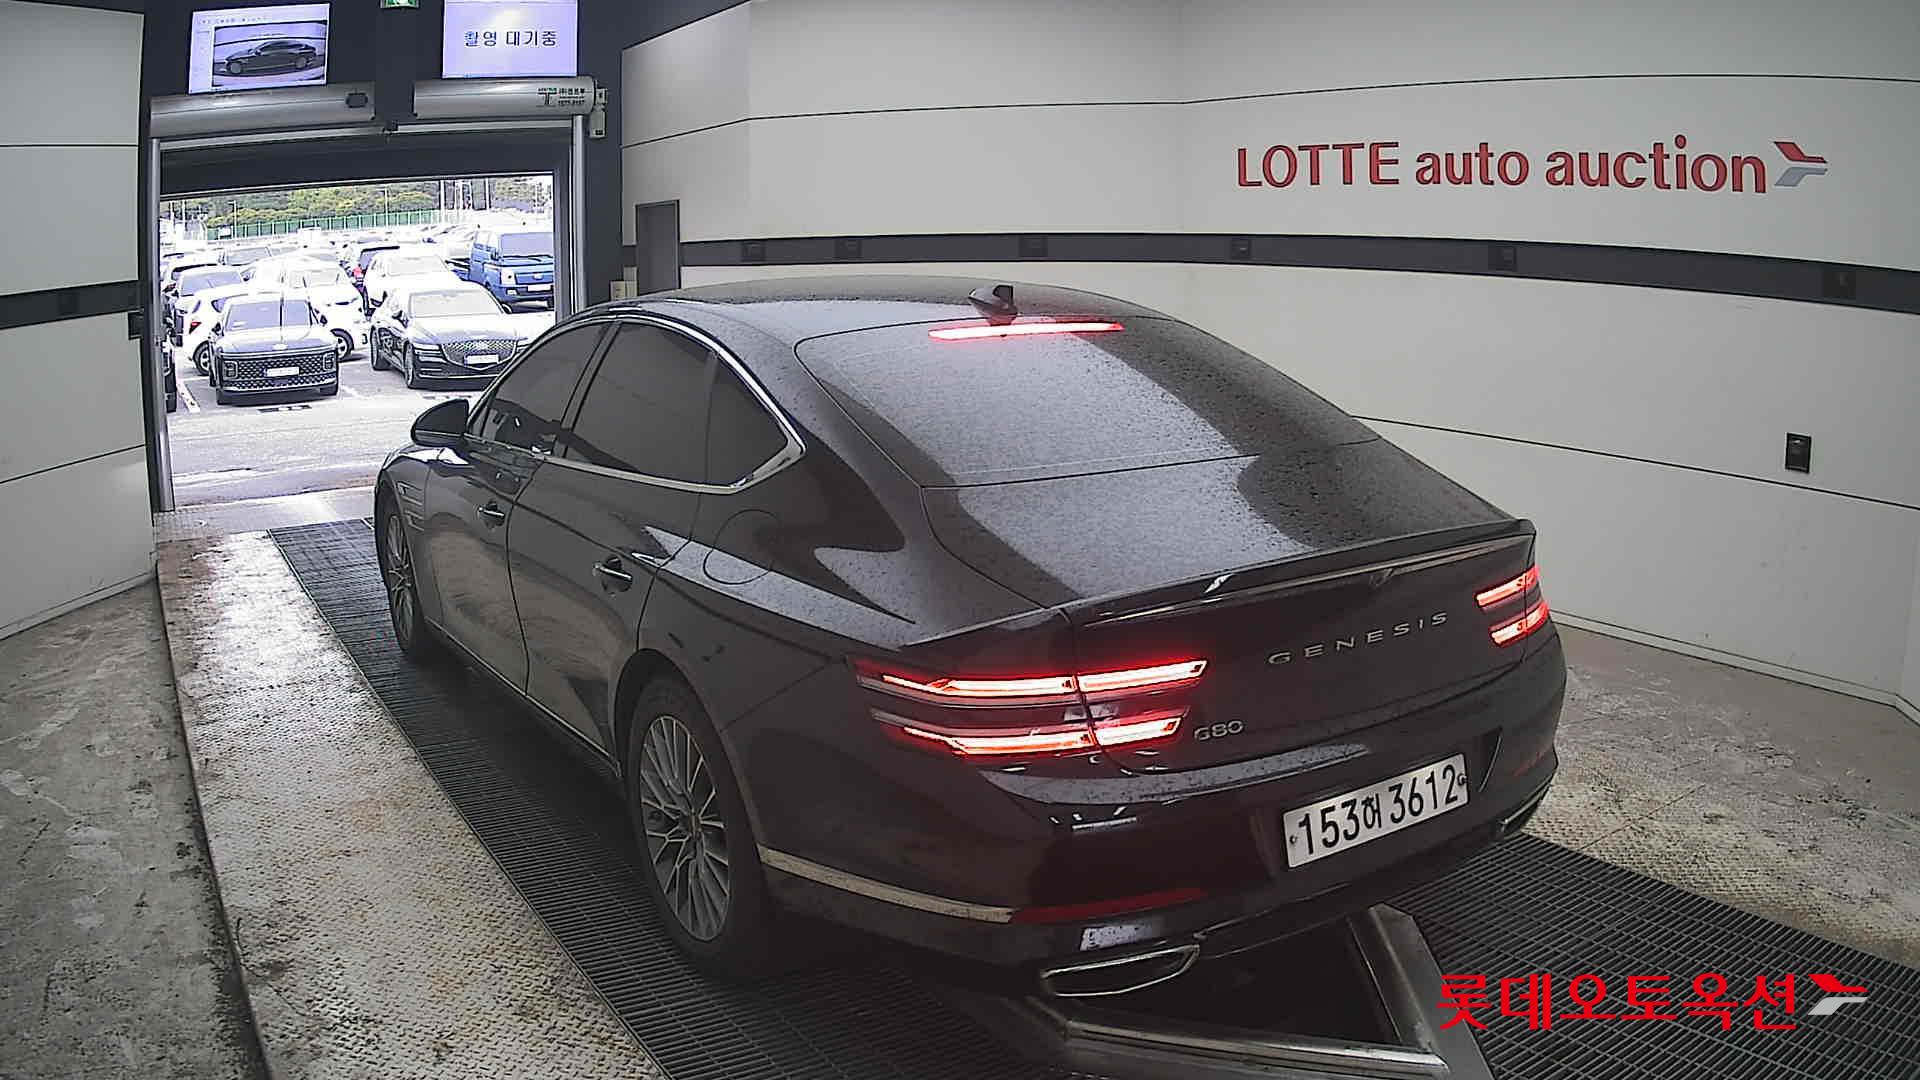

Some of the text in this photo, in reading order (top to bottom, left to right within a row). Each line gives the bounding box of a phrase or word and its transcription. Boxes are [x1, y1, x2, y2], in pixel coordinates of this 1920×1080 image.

[505, 30, 557, 47] 대기중
[1237, 134, 1767, 194] LOTTE auto auction
[1267, 611, 1448, 665] GENESIS
[1193, 719, 1244, 742] G80
